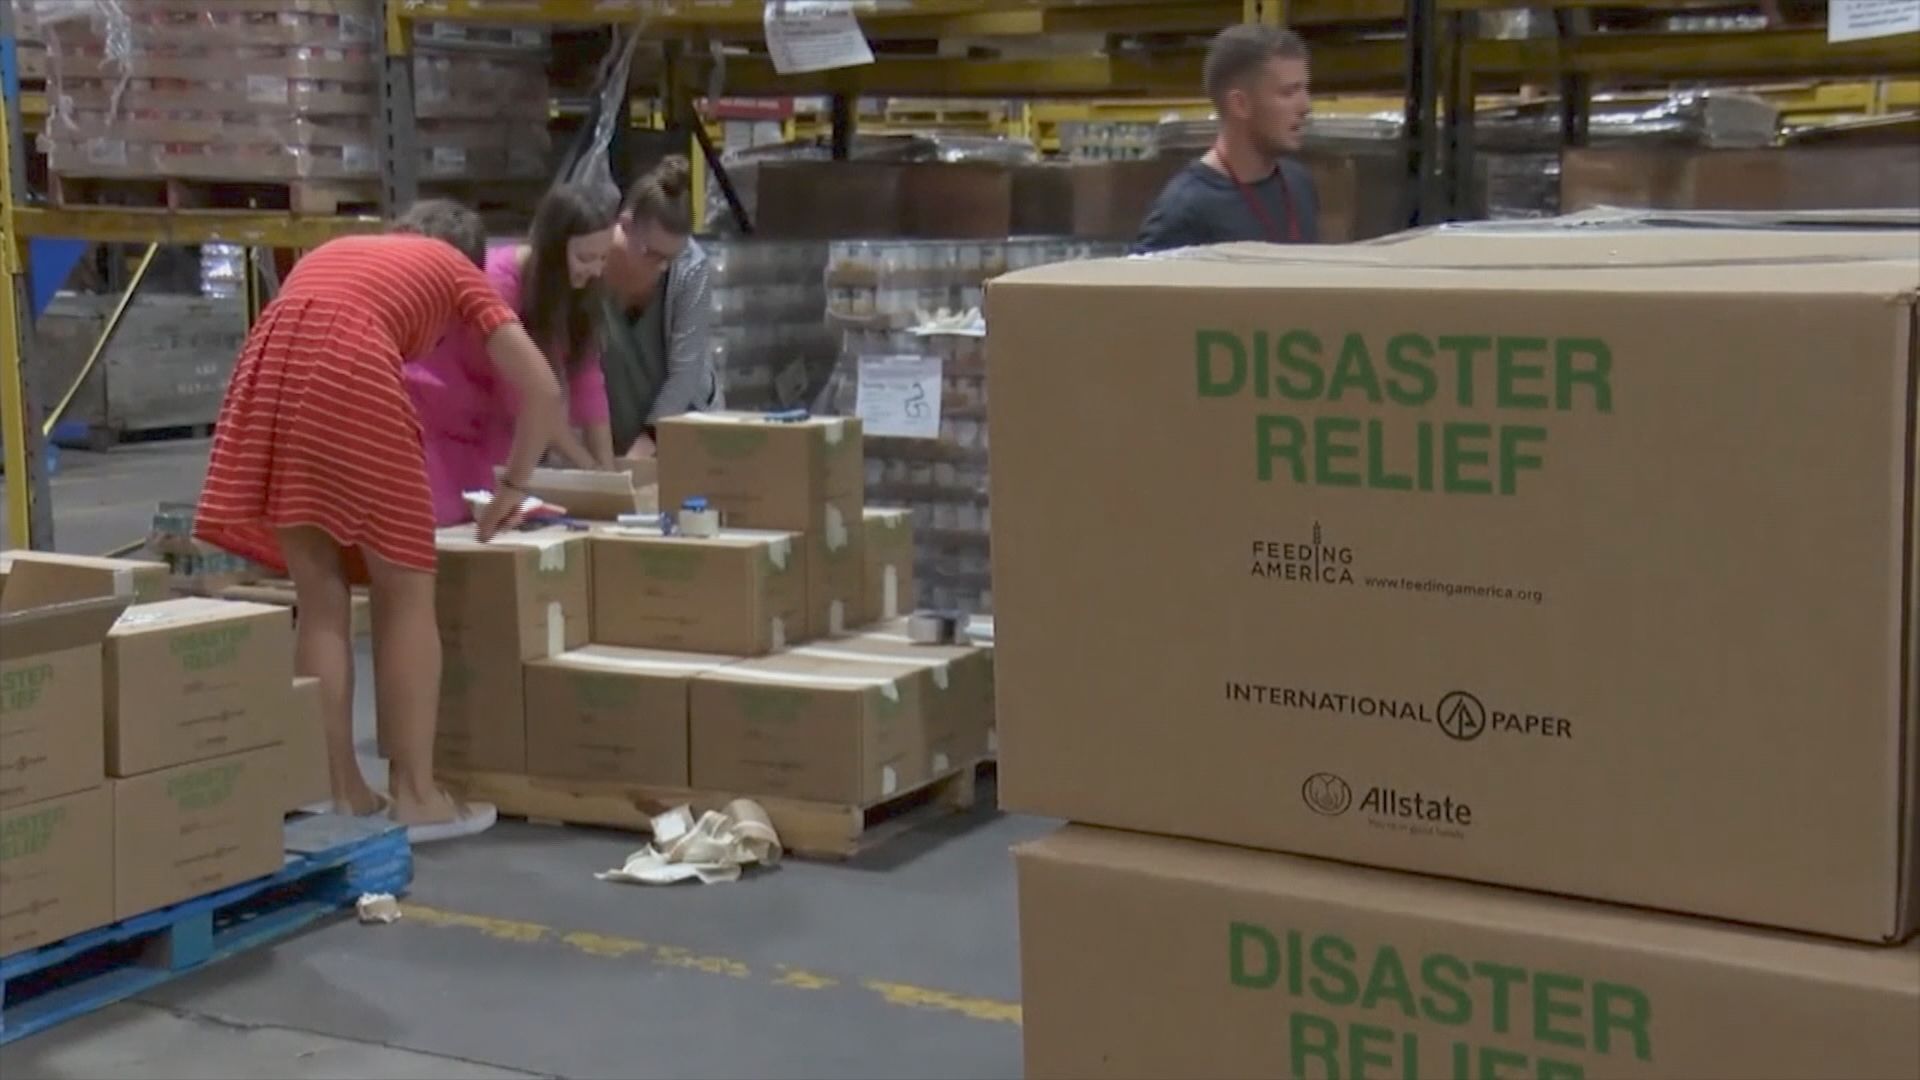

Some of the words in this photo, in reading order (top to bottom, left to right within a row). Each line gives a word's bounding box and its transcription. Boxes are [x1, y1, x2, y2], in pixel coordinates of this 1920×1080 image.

[1198, 329, 1615, 412] DISASTER
[1257, 414, 1547, 495] RELIEF
[1251, 540, 1354, 565] FEEDING
[1251, 560, 1355, 585] AMERICA
[1364, 576, 1543, 604] www.feedingamerica.org
[1226, 681, 1433, 724] INTERNATIONAL
[1492, 710, 1573, 740] PAPER
[1358, 786, 1472, 828] Allstate
[1230, 923, 1652, 1061] DISASTER
